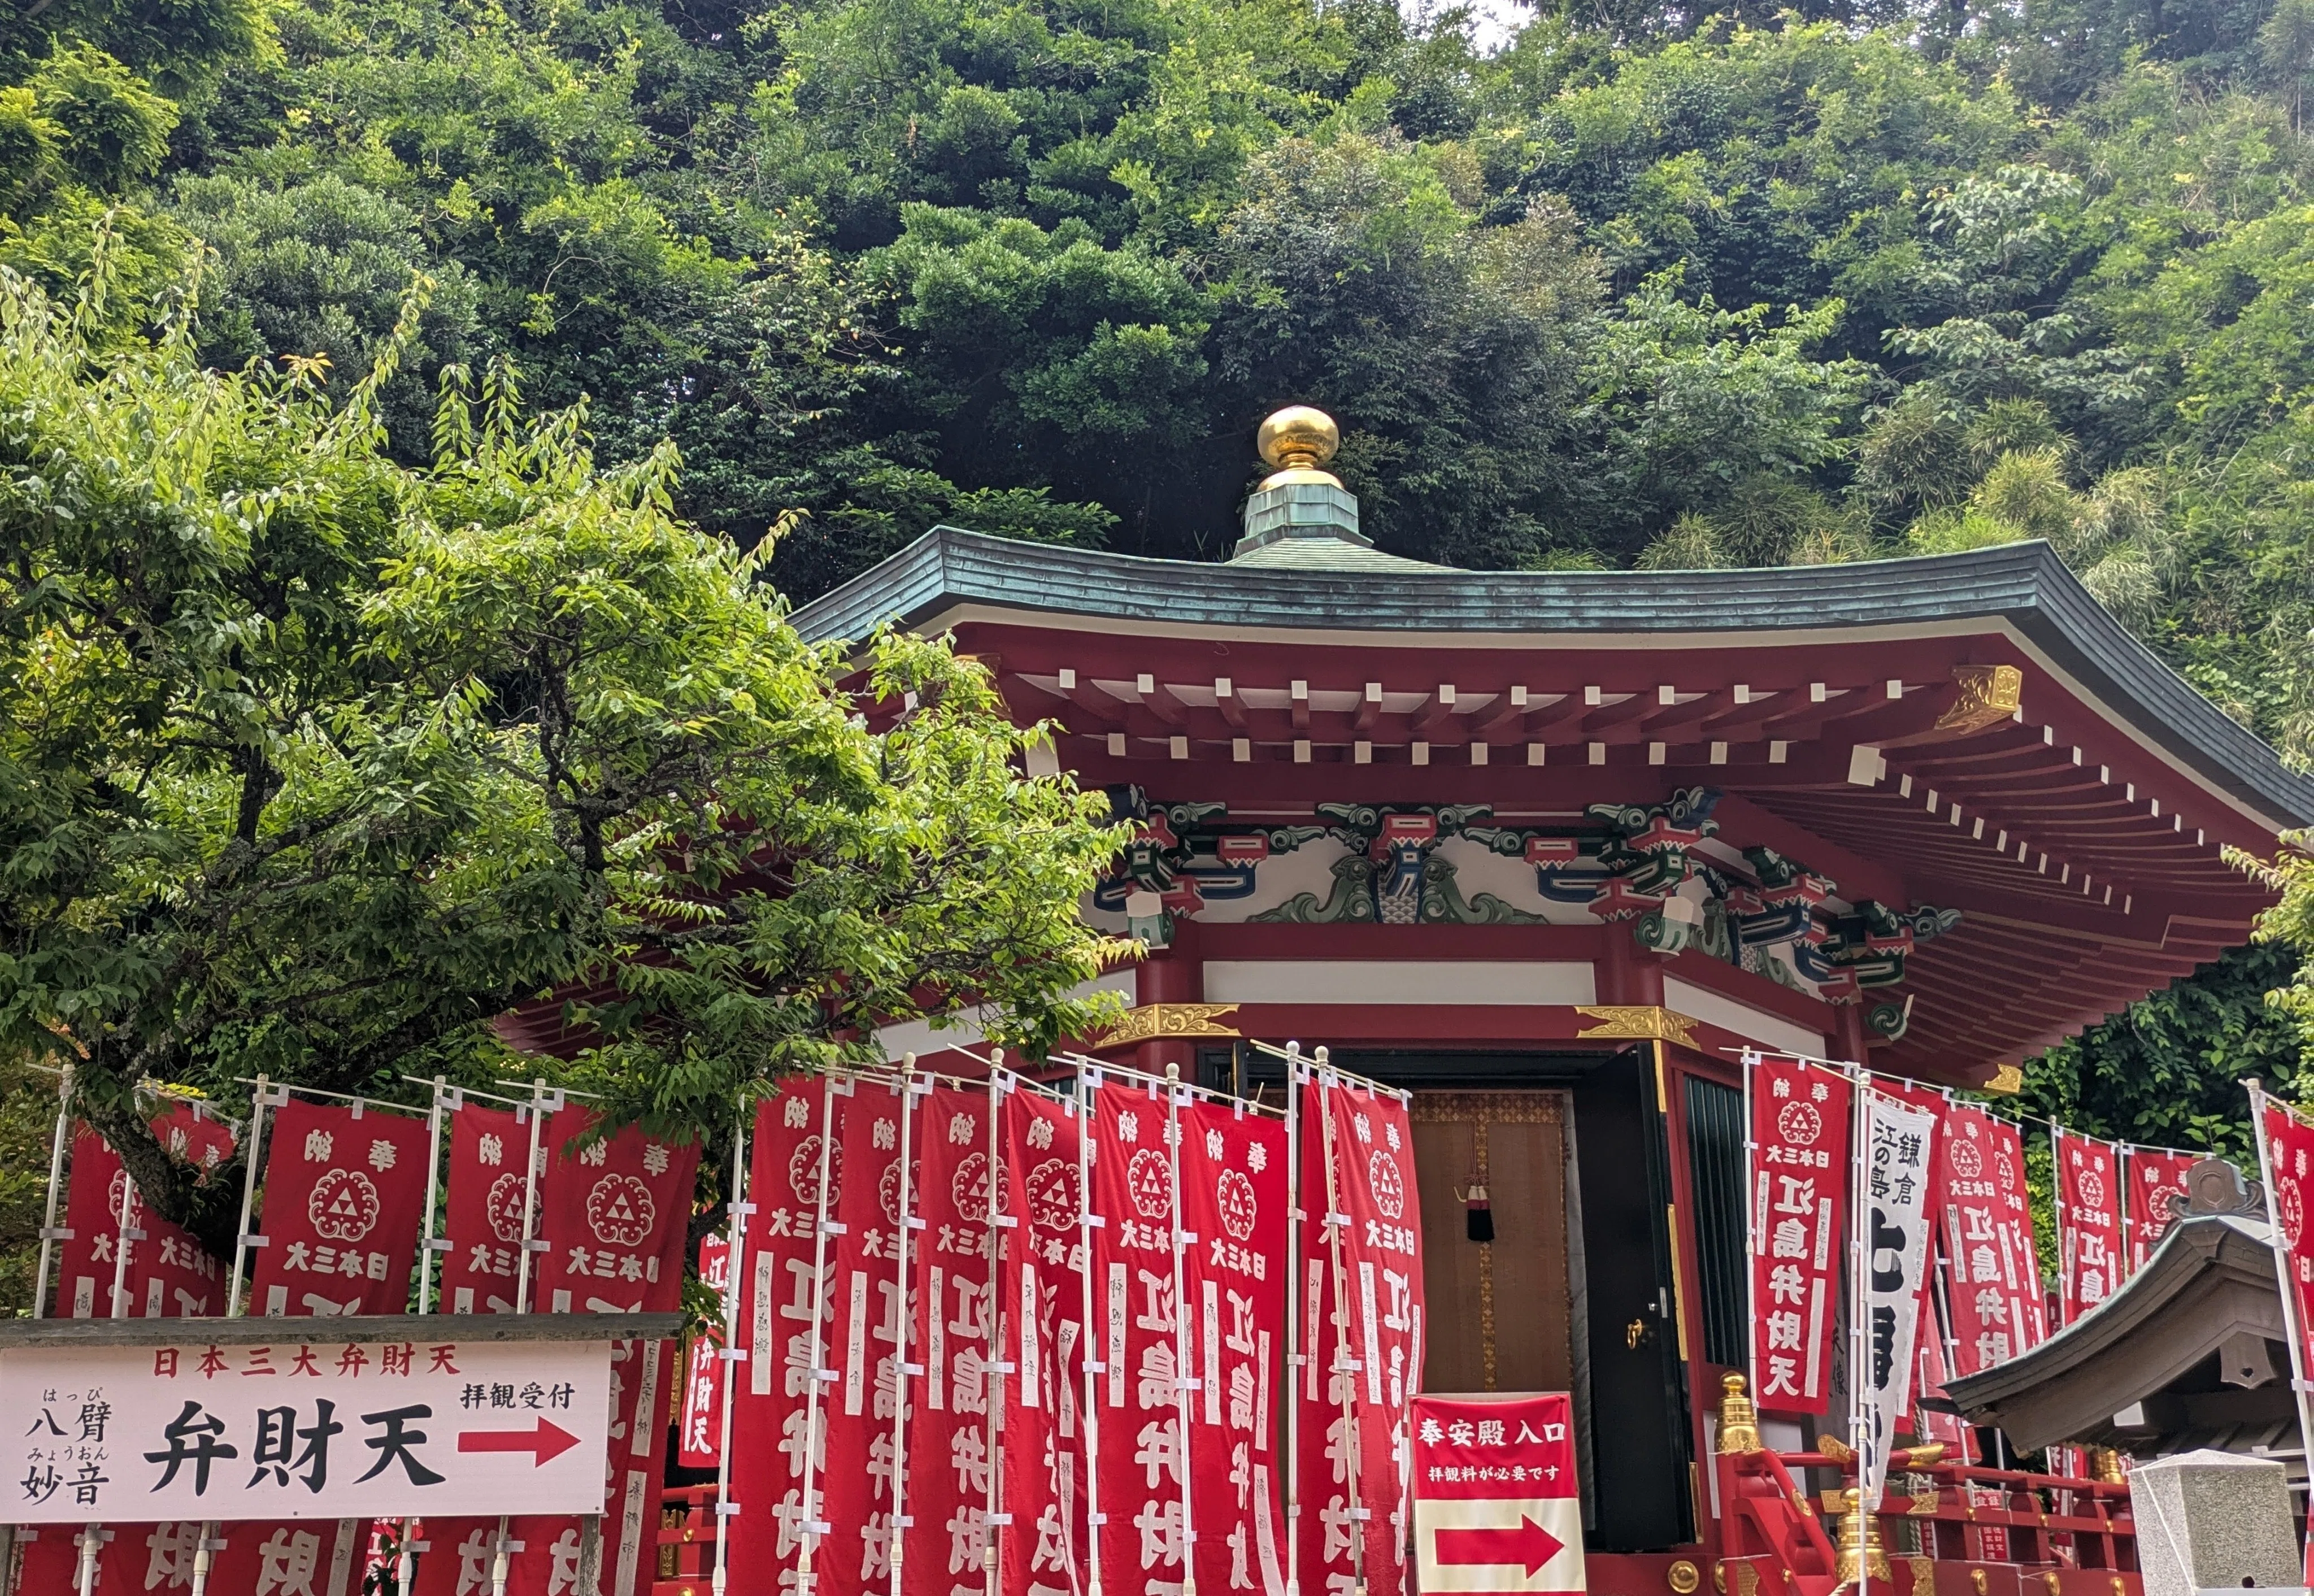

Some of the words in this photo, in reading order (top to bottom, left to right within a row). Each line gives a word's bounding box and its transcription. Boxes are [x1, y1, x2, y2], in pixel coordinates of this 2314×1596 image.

[1871, 1117, 1899, 1201] 江の島
[1891, 1132, 1922, 1206] 鎌倉
[153, 1343, 462, 1380] 日本三大弁財天
[43, 1388, 103, 1403] はっぴ
[459, 1382, 576, 1411] 拝観受付
[25, 1399, 112, 1444] 八臂
[1418, 1419, 1507, 1447] 奉安殿
[1515, 1420, 1565, 1444] 入口
[26, 1447, 110, 1462] みょうおん
[143, 1398, 447, 1496] 弁財天
[19, 1465, 110, 1506] 妙音
[1428, 1465, 1559, 1482] 拝観料が必要です
